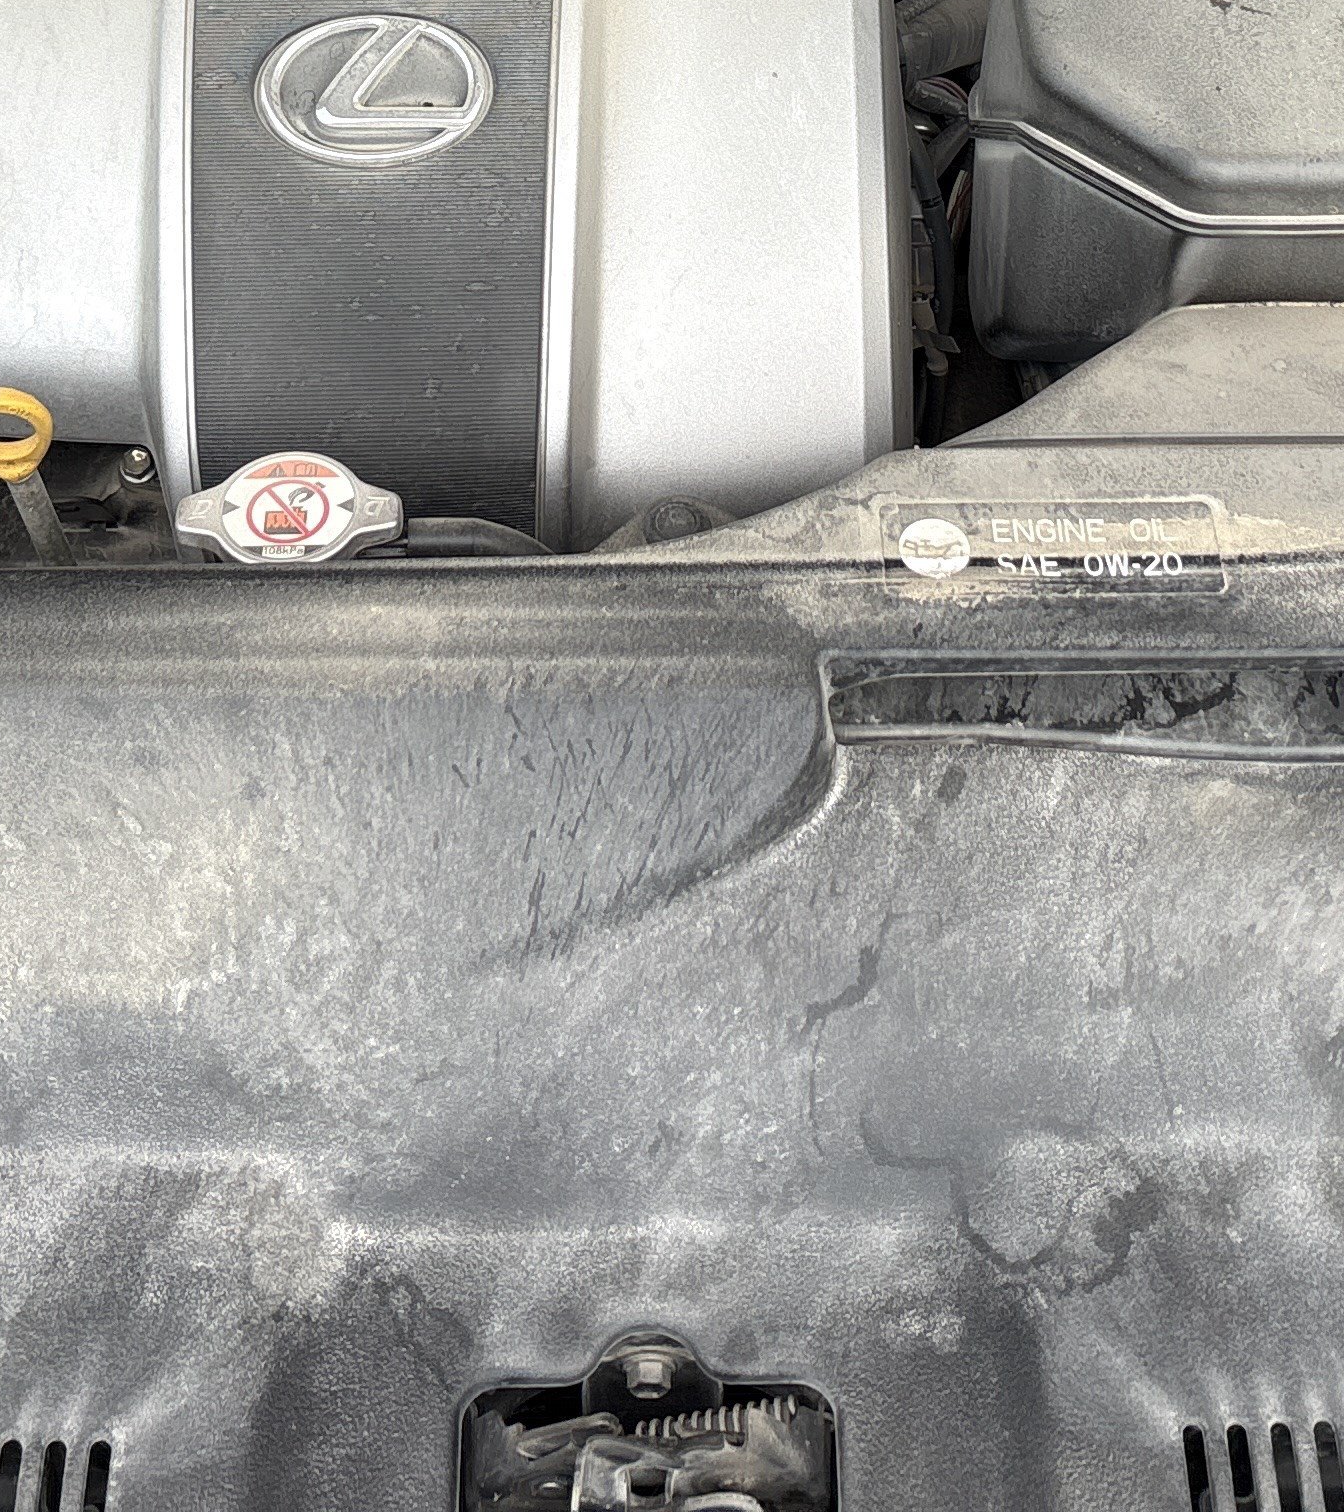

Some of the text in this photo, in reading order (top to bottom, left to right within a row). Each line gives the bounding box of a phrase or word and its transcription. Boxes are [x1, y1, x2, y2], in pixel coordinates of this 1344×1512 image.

[990, 518, 1176, 543] ENGINE OIL
[997, 552, 1183, 577] SAE 0W-20
